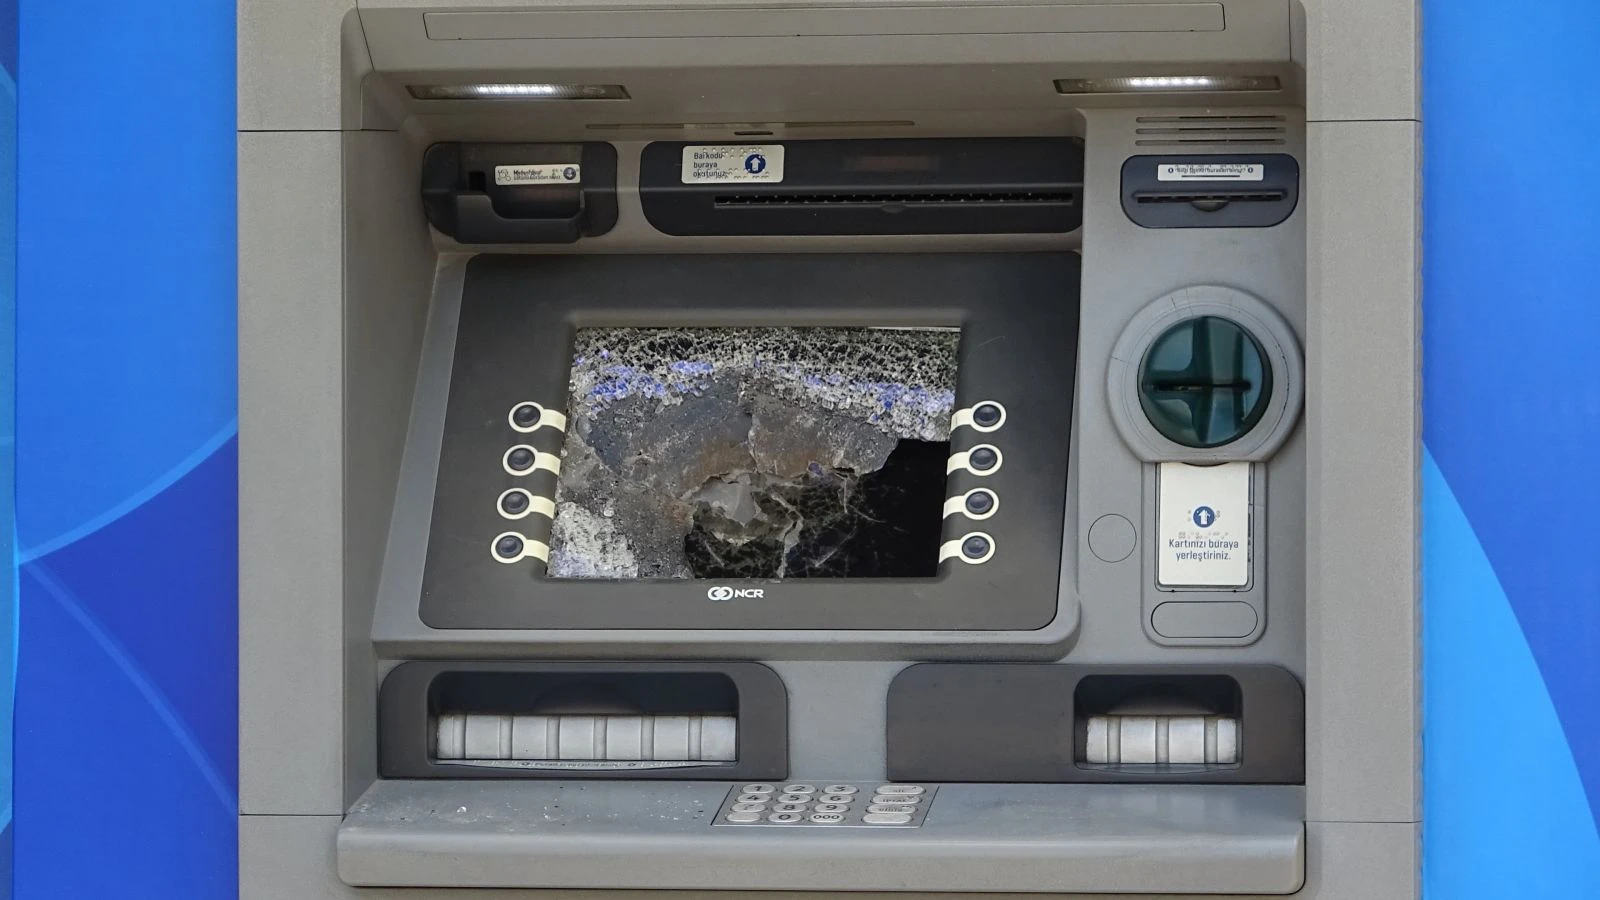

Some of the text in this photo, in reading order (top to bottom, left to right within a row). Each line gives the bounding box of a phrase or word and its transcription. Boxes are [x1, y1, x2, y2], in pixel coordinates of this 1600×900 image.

[693, 152, 723, 160] Barkodu
[693, 161, 718, 169] buraya
[1168, 538, 1239, 550] Kartınızı buraya
[1176, 550, 1232, 562] yerleştiriniz.
[734, 589, 764, 598] NCR
